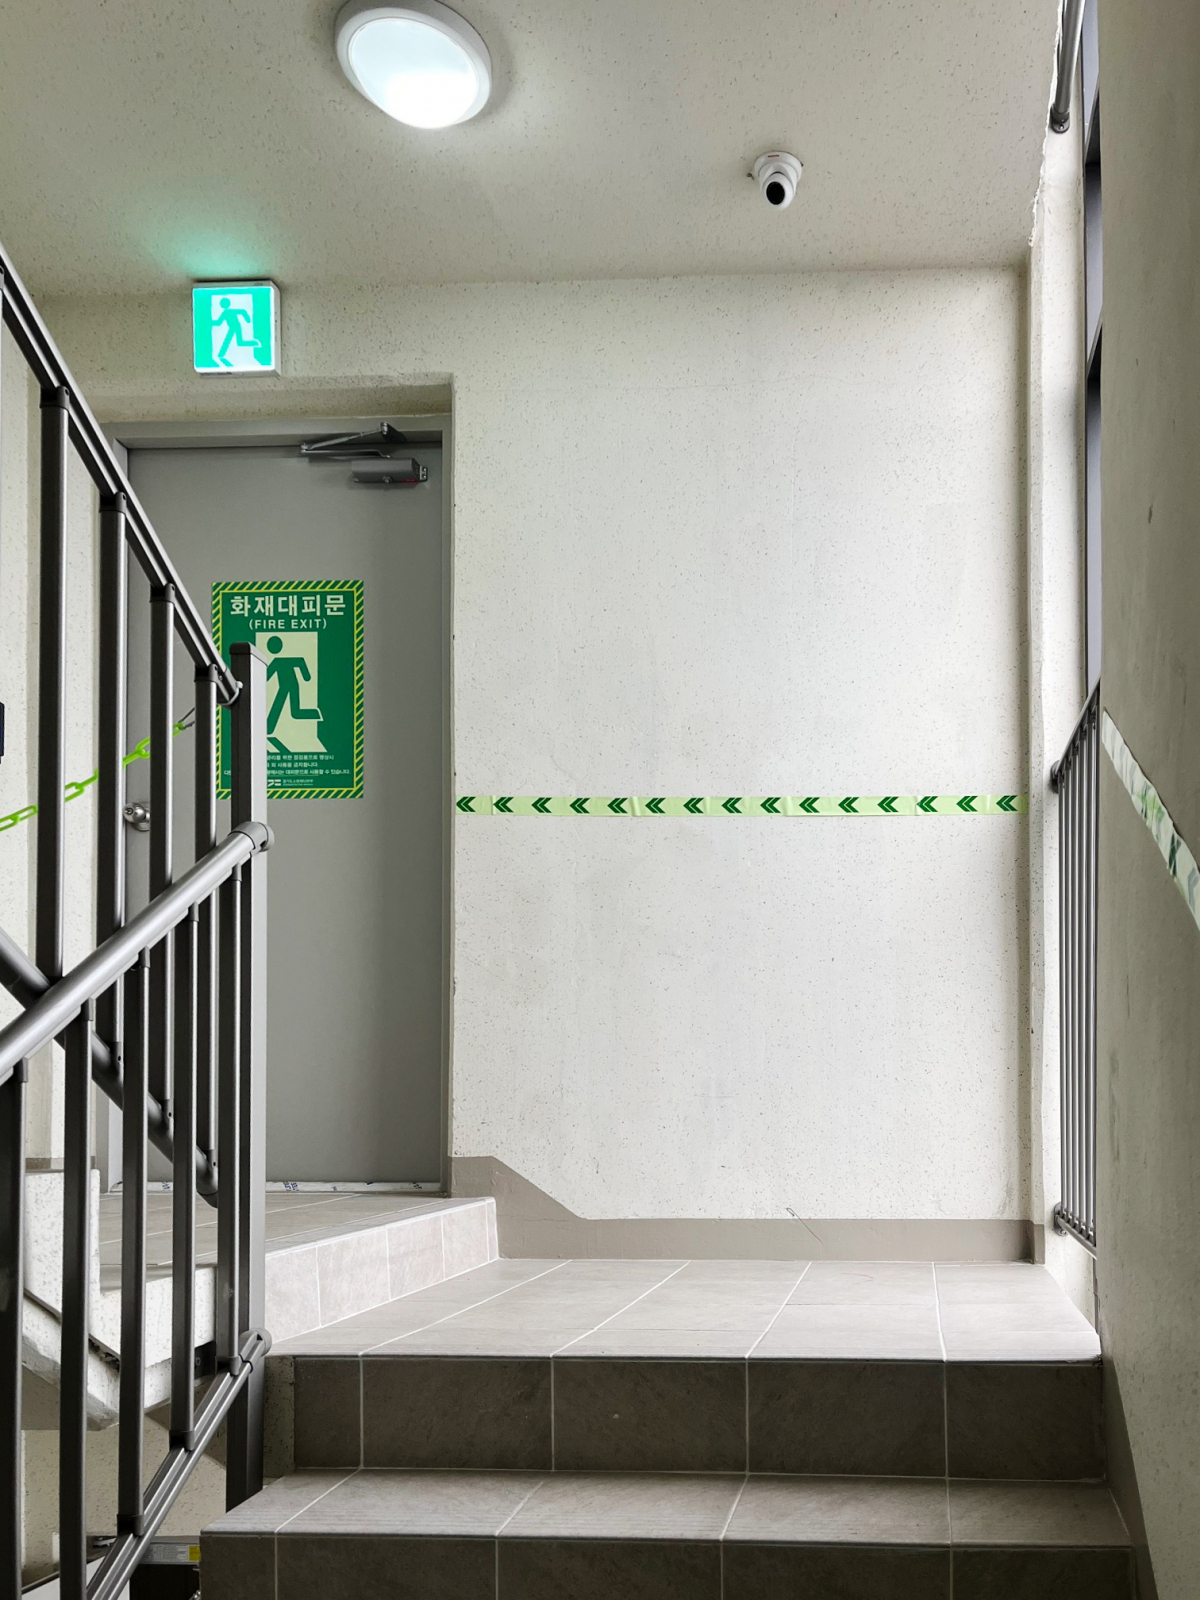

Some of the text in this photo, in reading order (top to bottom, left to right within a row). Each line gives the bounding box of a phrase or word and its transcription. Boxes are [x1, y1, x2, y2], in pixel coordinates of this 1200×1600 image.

[230, 594, 346, 617] 화재대피문
[249, 618, 327, 630] (FIRE EXIT)
